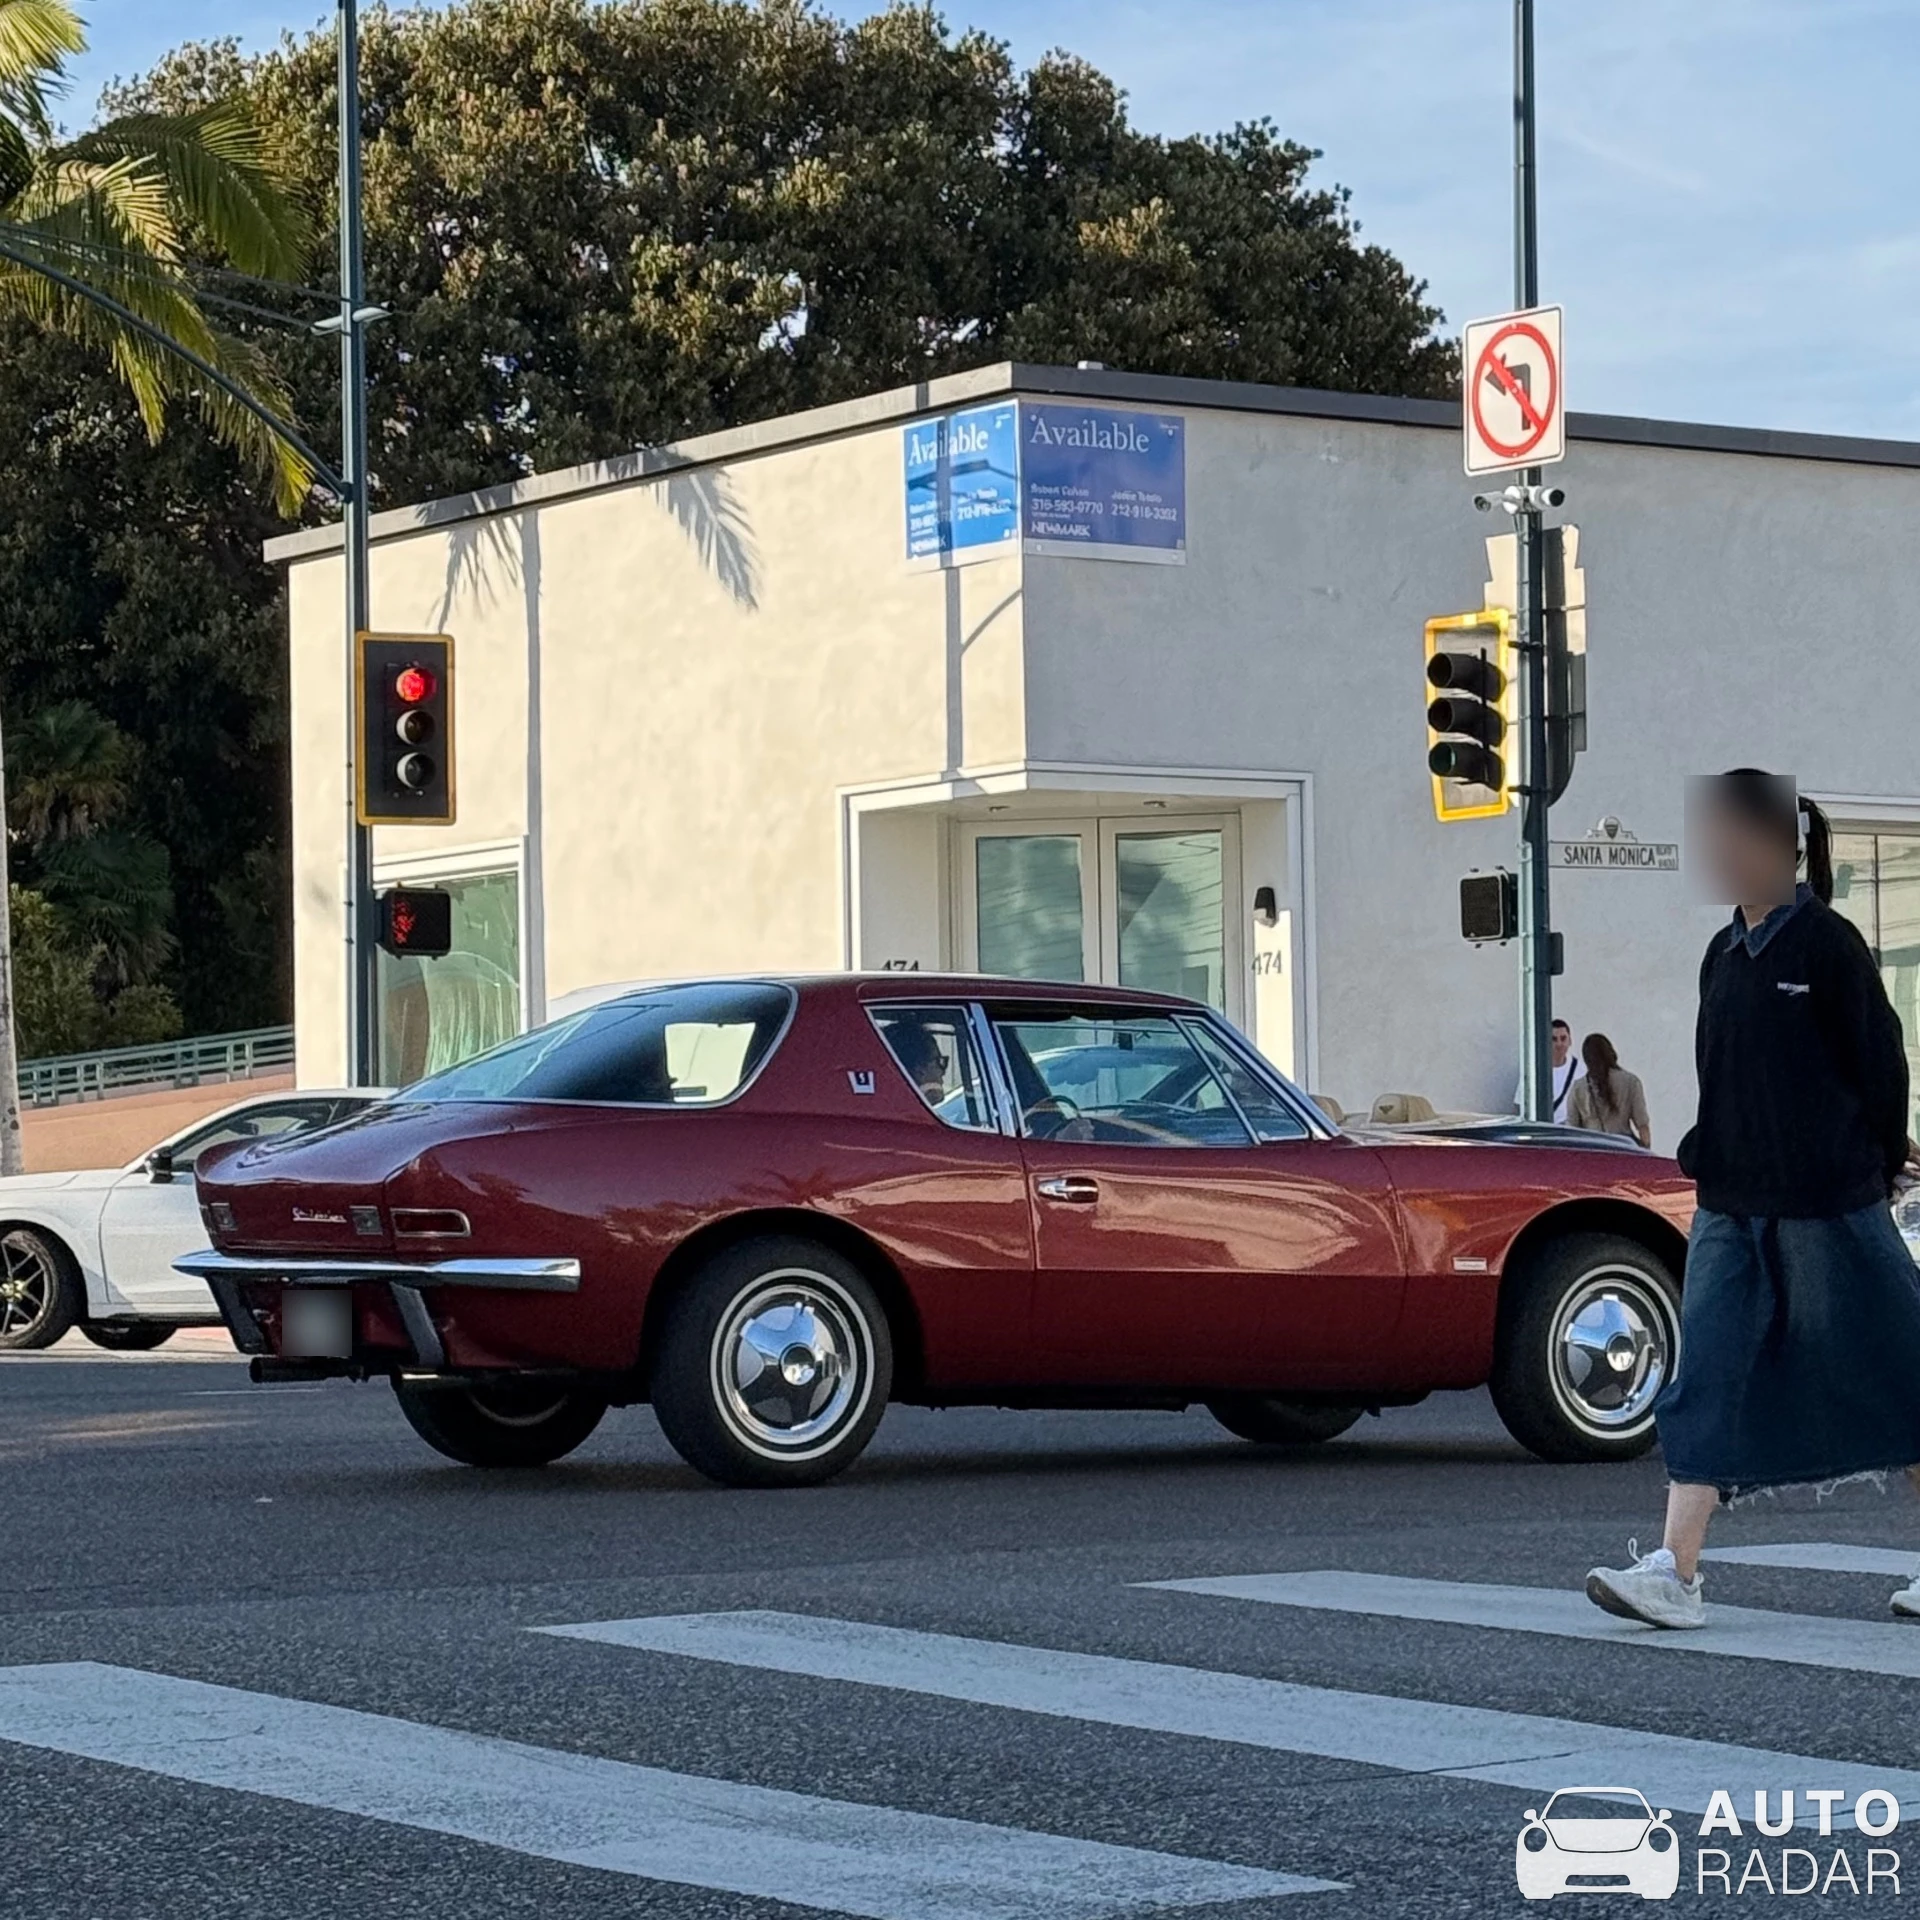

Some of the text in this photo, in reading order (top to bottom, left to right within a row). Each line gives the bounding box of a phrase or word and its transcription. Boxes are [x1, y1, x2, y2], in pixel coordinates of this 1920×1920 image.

[908, 422, 989, 467] Available
[1030, 417, 1150, 453] Available
[1564, 845, 1602, 866] SANTA
[1608, 846, 1656, 866] MONICA
[1251, 949, 1282, 975] 474
